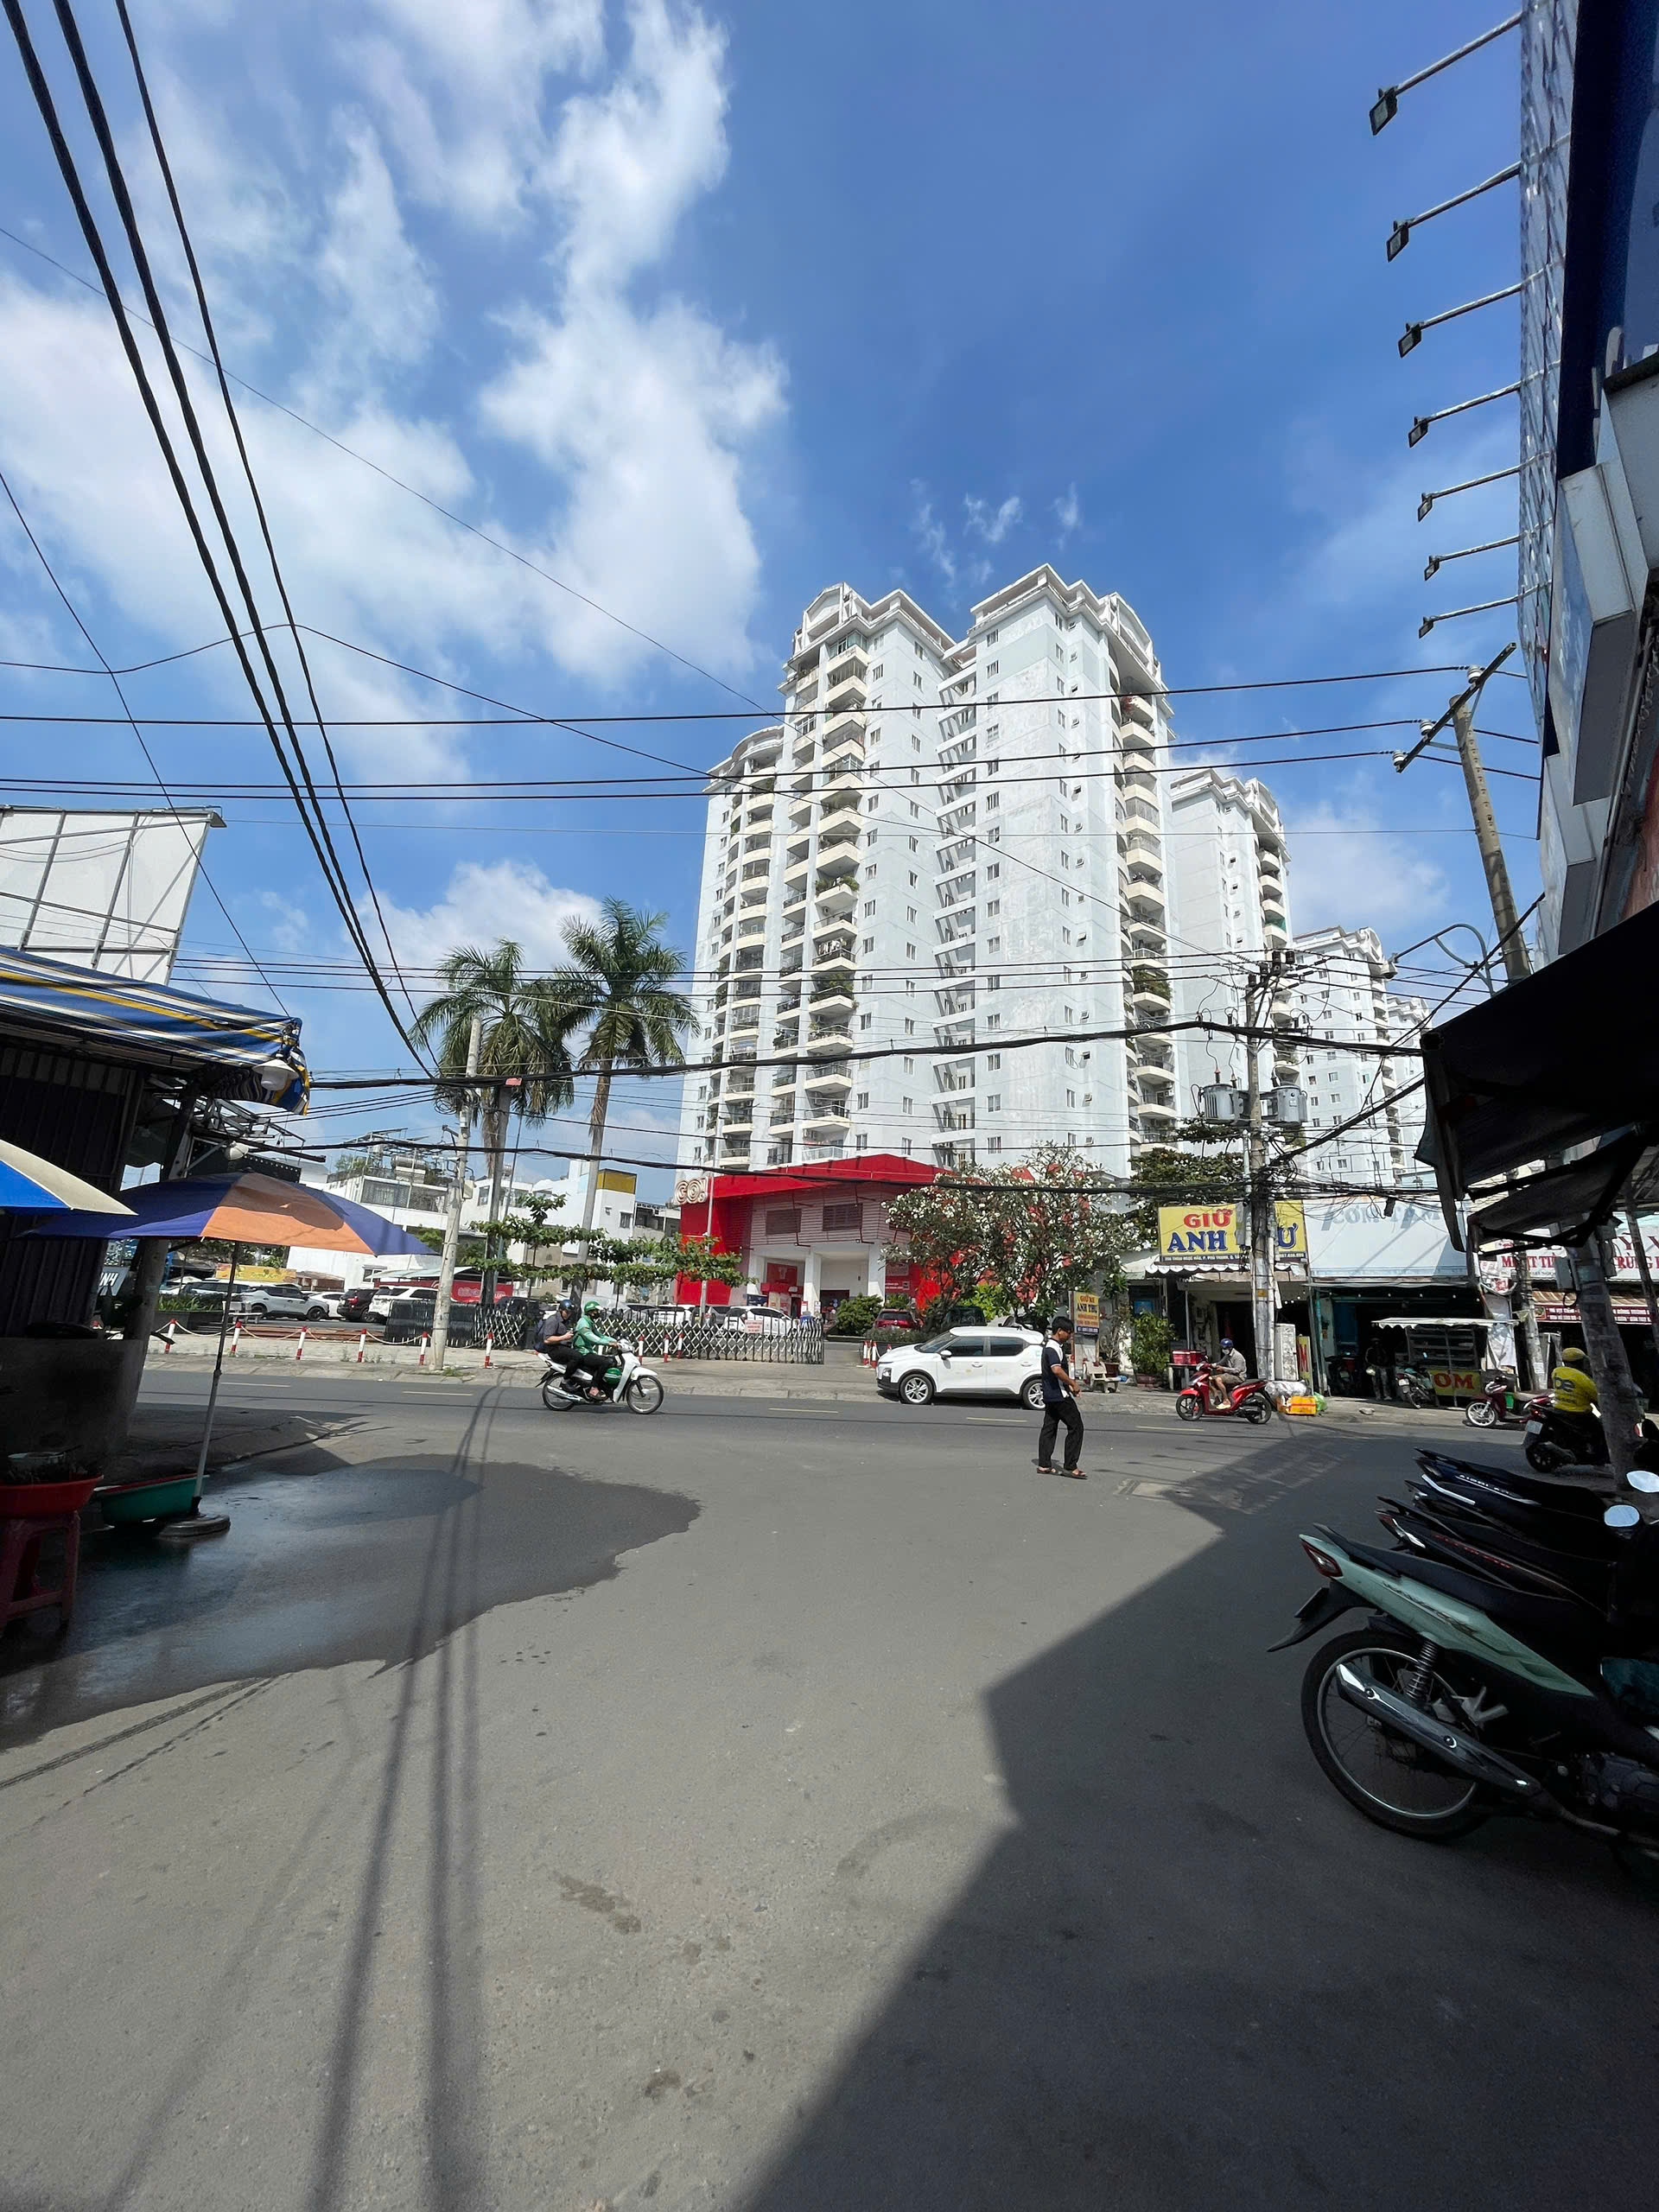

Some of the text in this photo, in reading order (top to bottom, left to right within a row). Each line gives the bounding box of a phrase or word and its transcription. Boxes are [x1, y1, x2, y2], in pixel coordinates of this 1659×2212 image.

[675, 1178, 708, 1205] GO!
[1184, 1209, 1233, 1229] GIỮ
[1167, 1230, 1228, 1252] ANH
